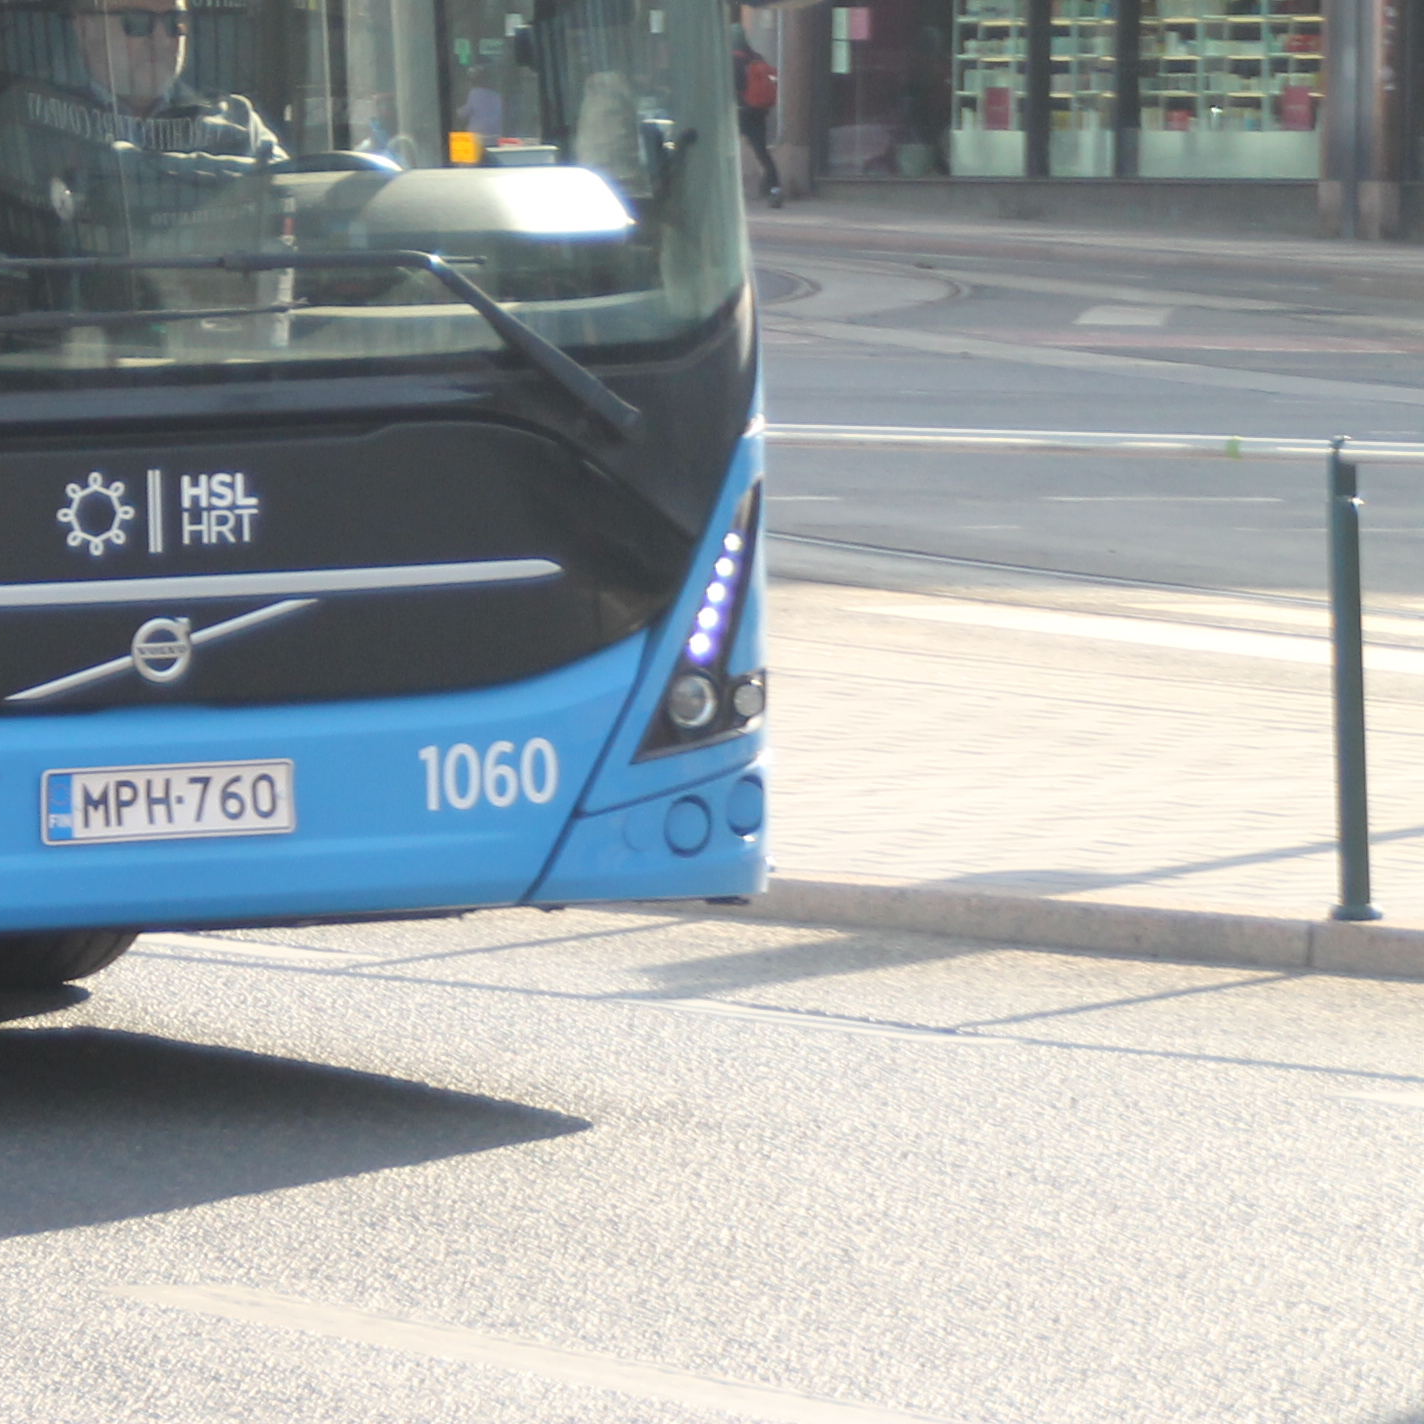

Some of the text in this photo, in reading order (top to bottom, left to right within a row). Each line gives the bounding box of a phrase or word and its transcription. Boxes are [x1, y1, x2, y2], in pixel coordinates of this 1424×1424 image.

[180, 472, 259, 509] HSL
[182, 509, 259, 545] HRT
[417, 736, 559, 812] 1060
[81, 773, 279, 829] MPH-760
